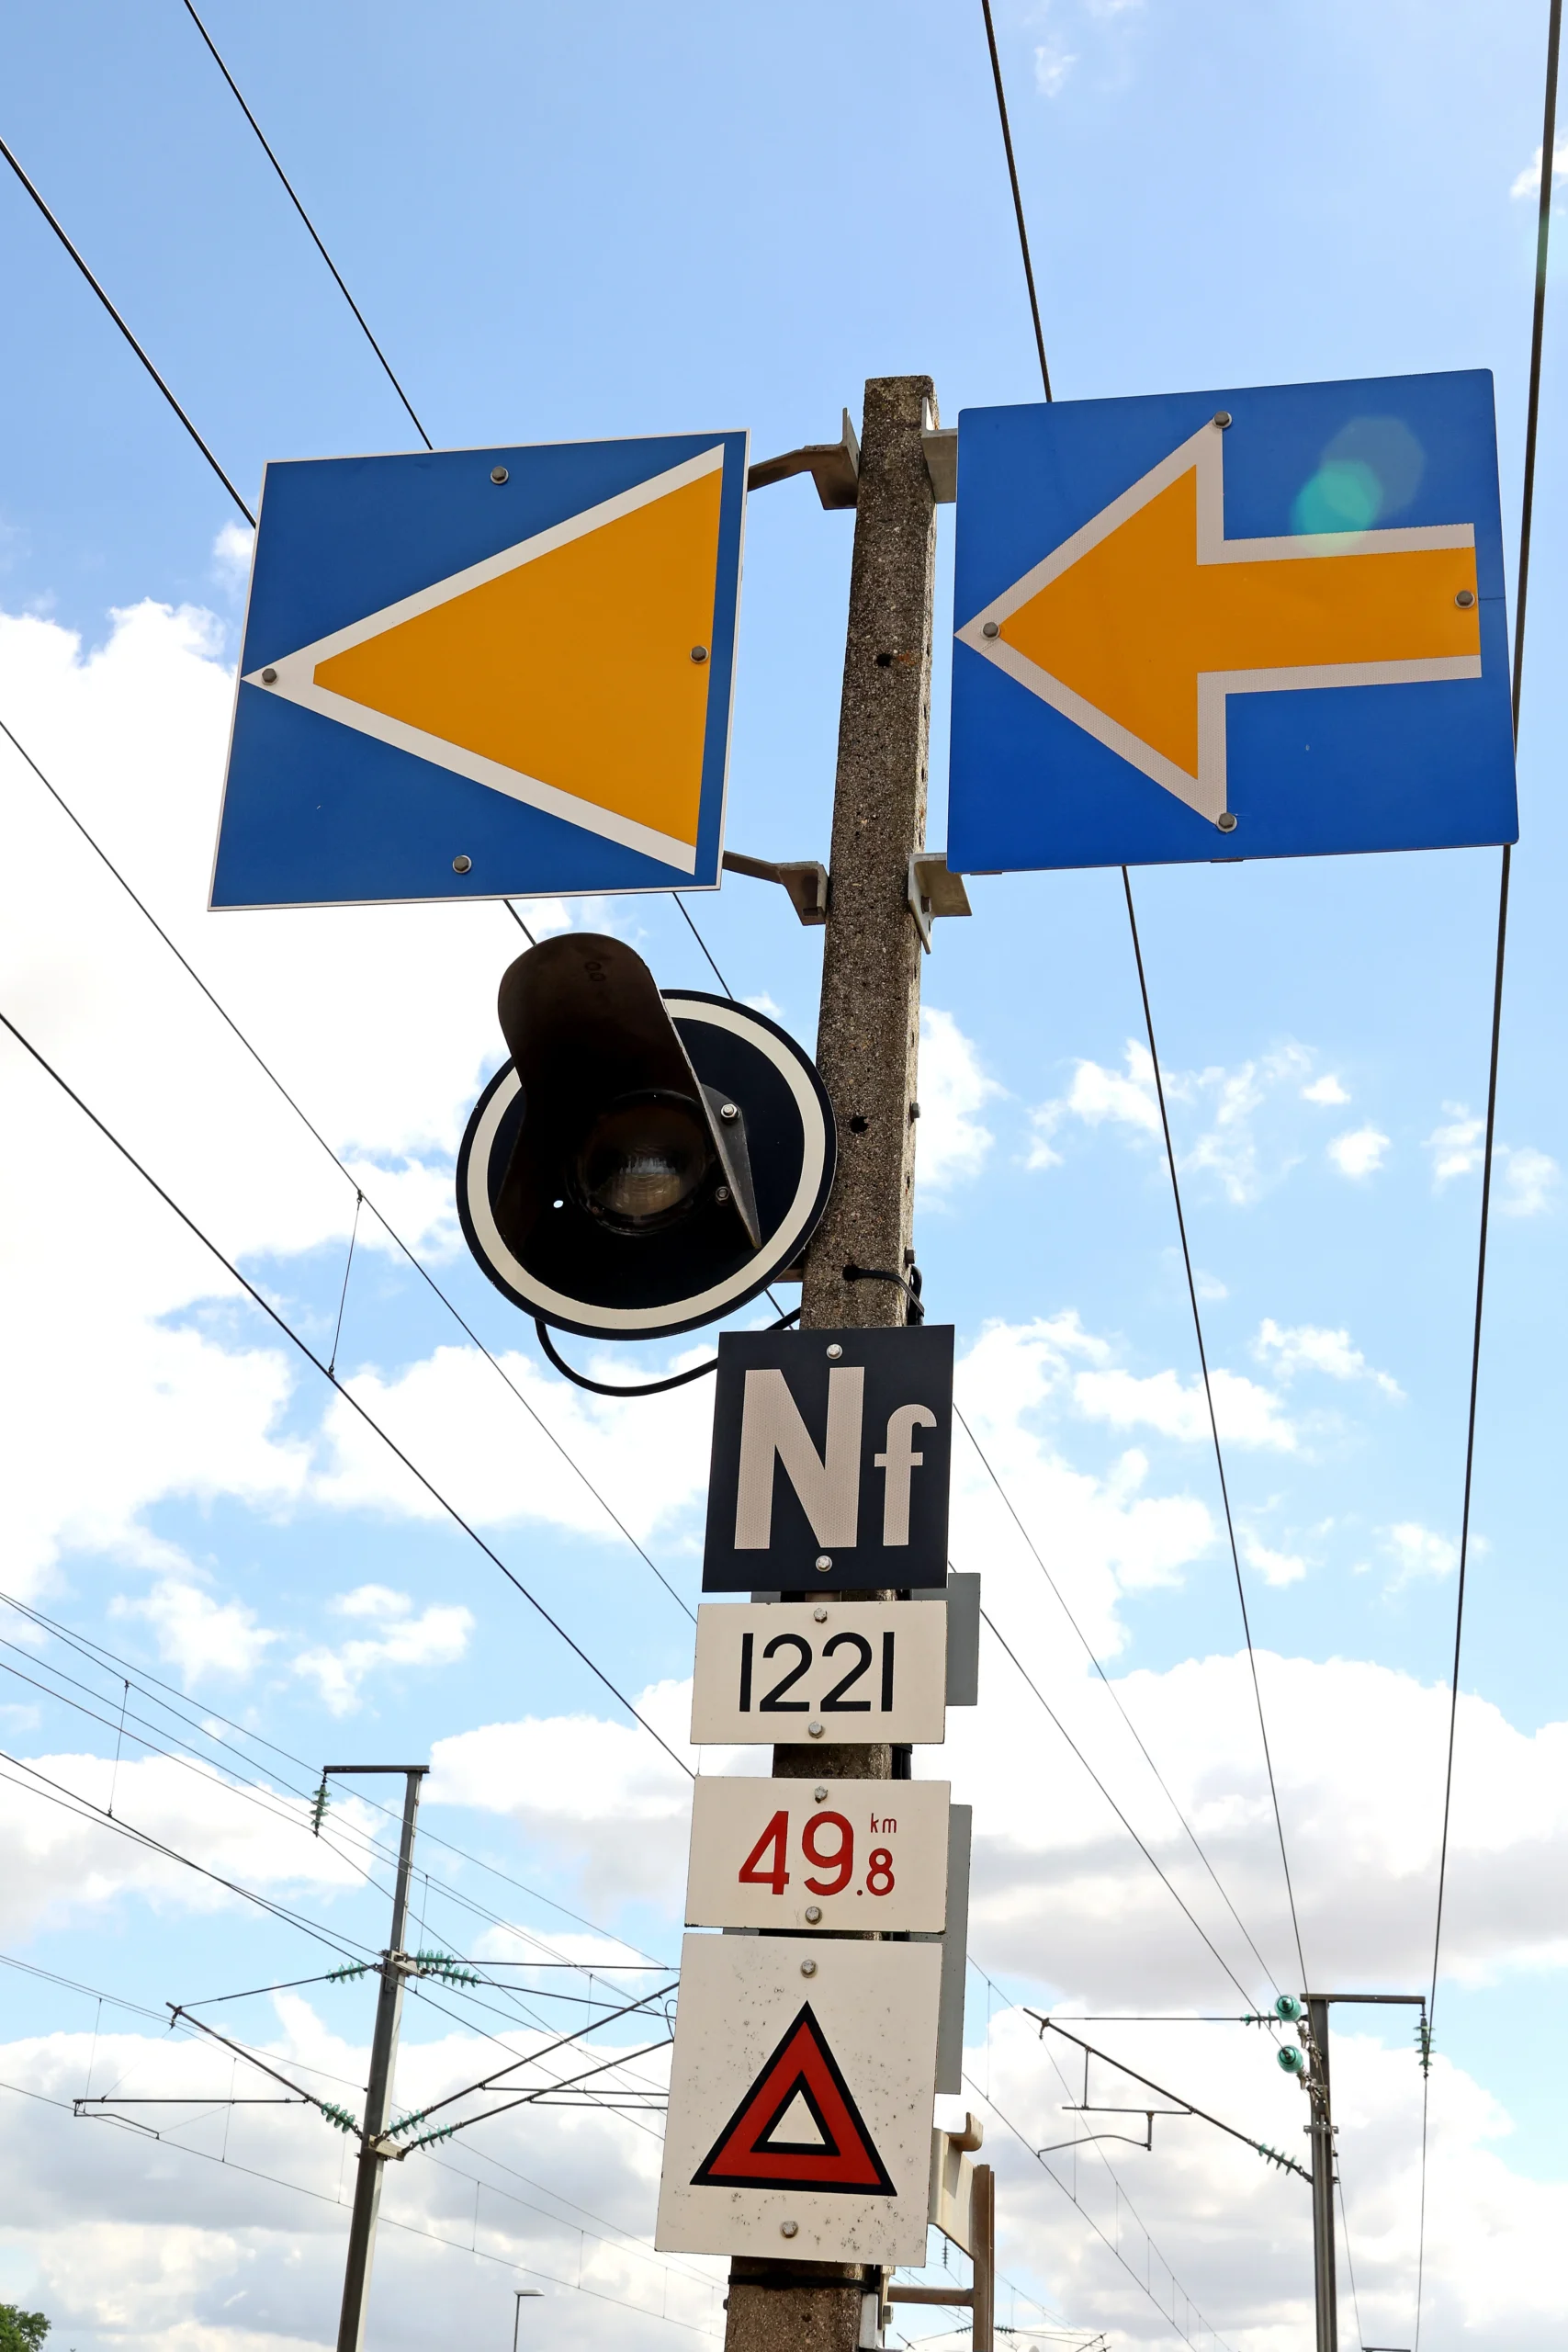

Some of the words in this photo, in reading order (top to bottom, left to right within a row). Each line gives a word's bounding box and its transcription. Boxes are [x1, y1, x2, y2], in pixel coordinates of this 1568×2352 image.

[734, 1366, 938, 1550] Nf
[739, 1632, 896, 1713] 1221
[870, 1813, 897, 1834] km
